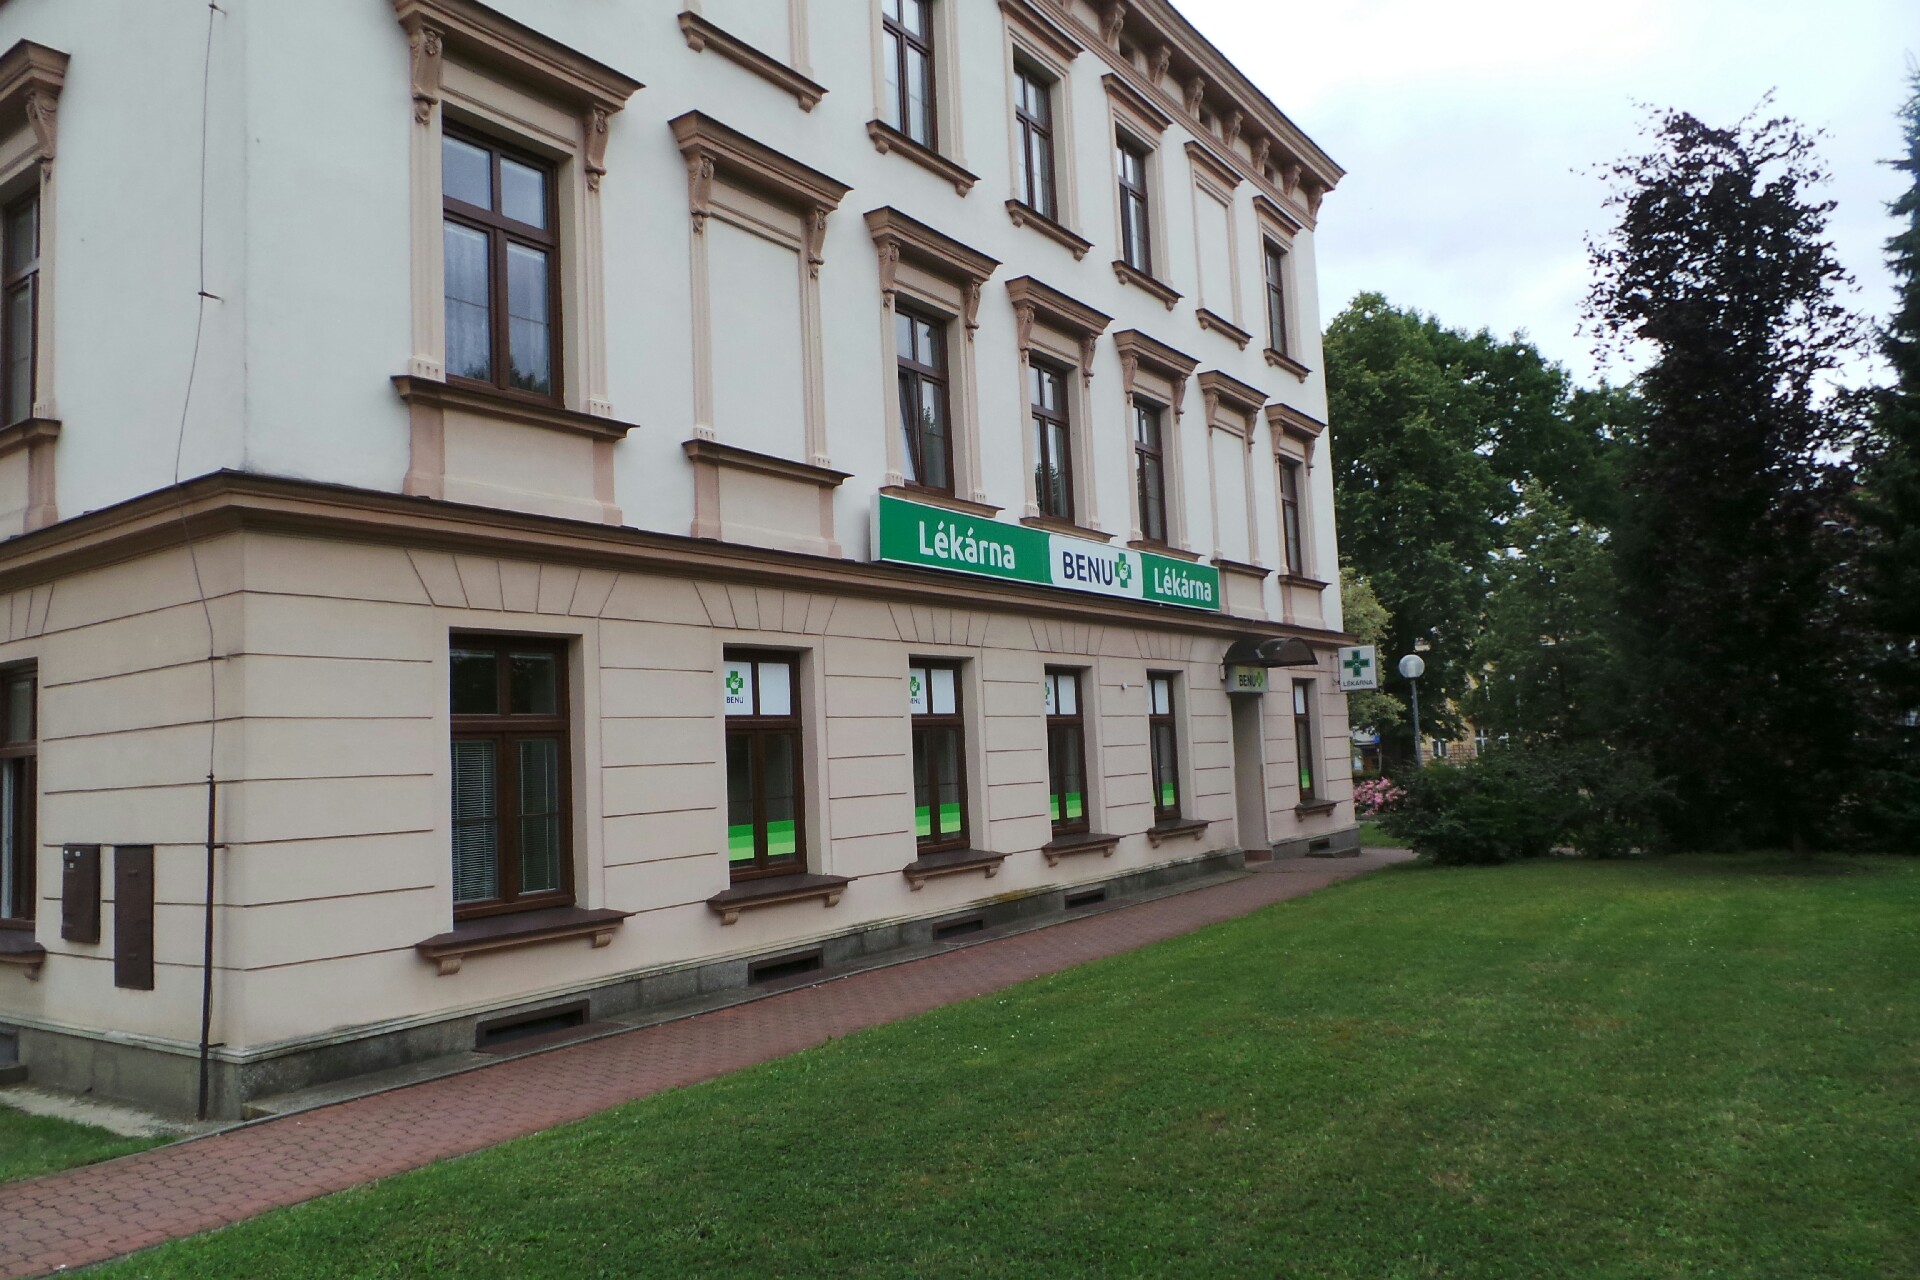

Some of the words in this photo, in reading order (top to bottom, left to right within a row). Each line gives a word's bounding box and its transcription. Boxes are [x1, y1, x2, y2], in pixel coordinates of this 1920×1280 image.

[918, 519, 1016, 569] Lékárna
[1062, 551, 1113, 586] BENU
[1154, 567, 1212, 602] Lékárna
[1238, 674, 1257, 687] BENU
[726, 696, 744, 704] BENU
